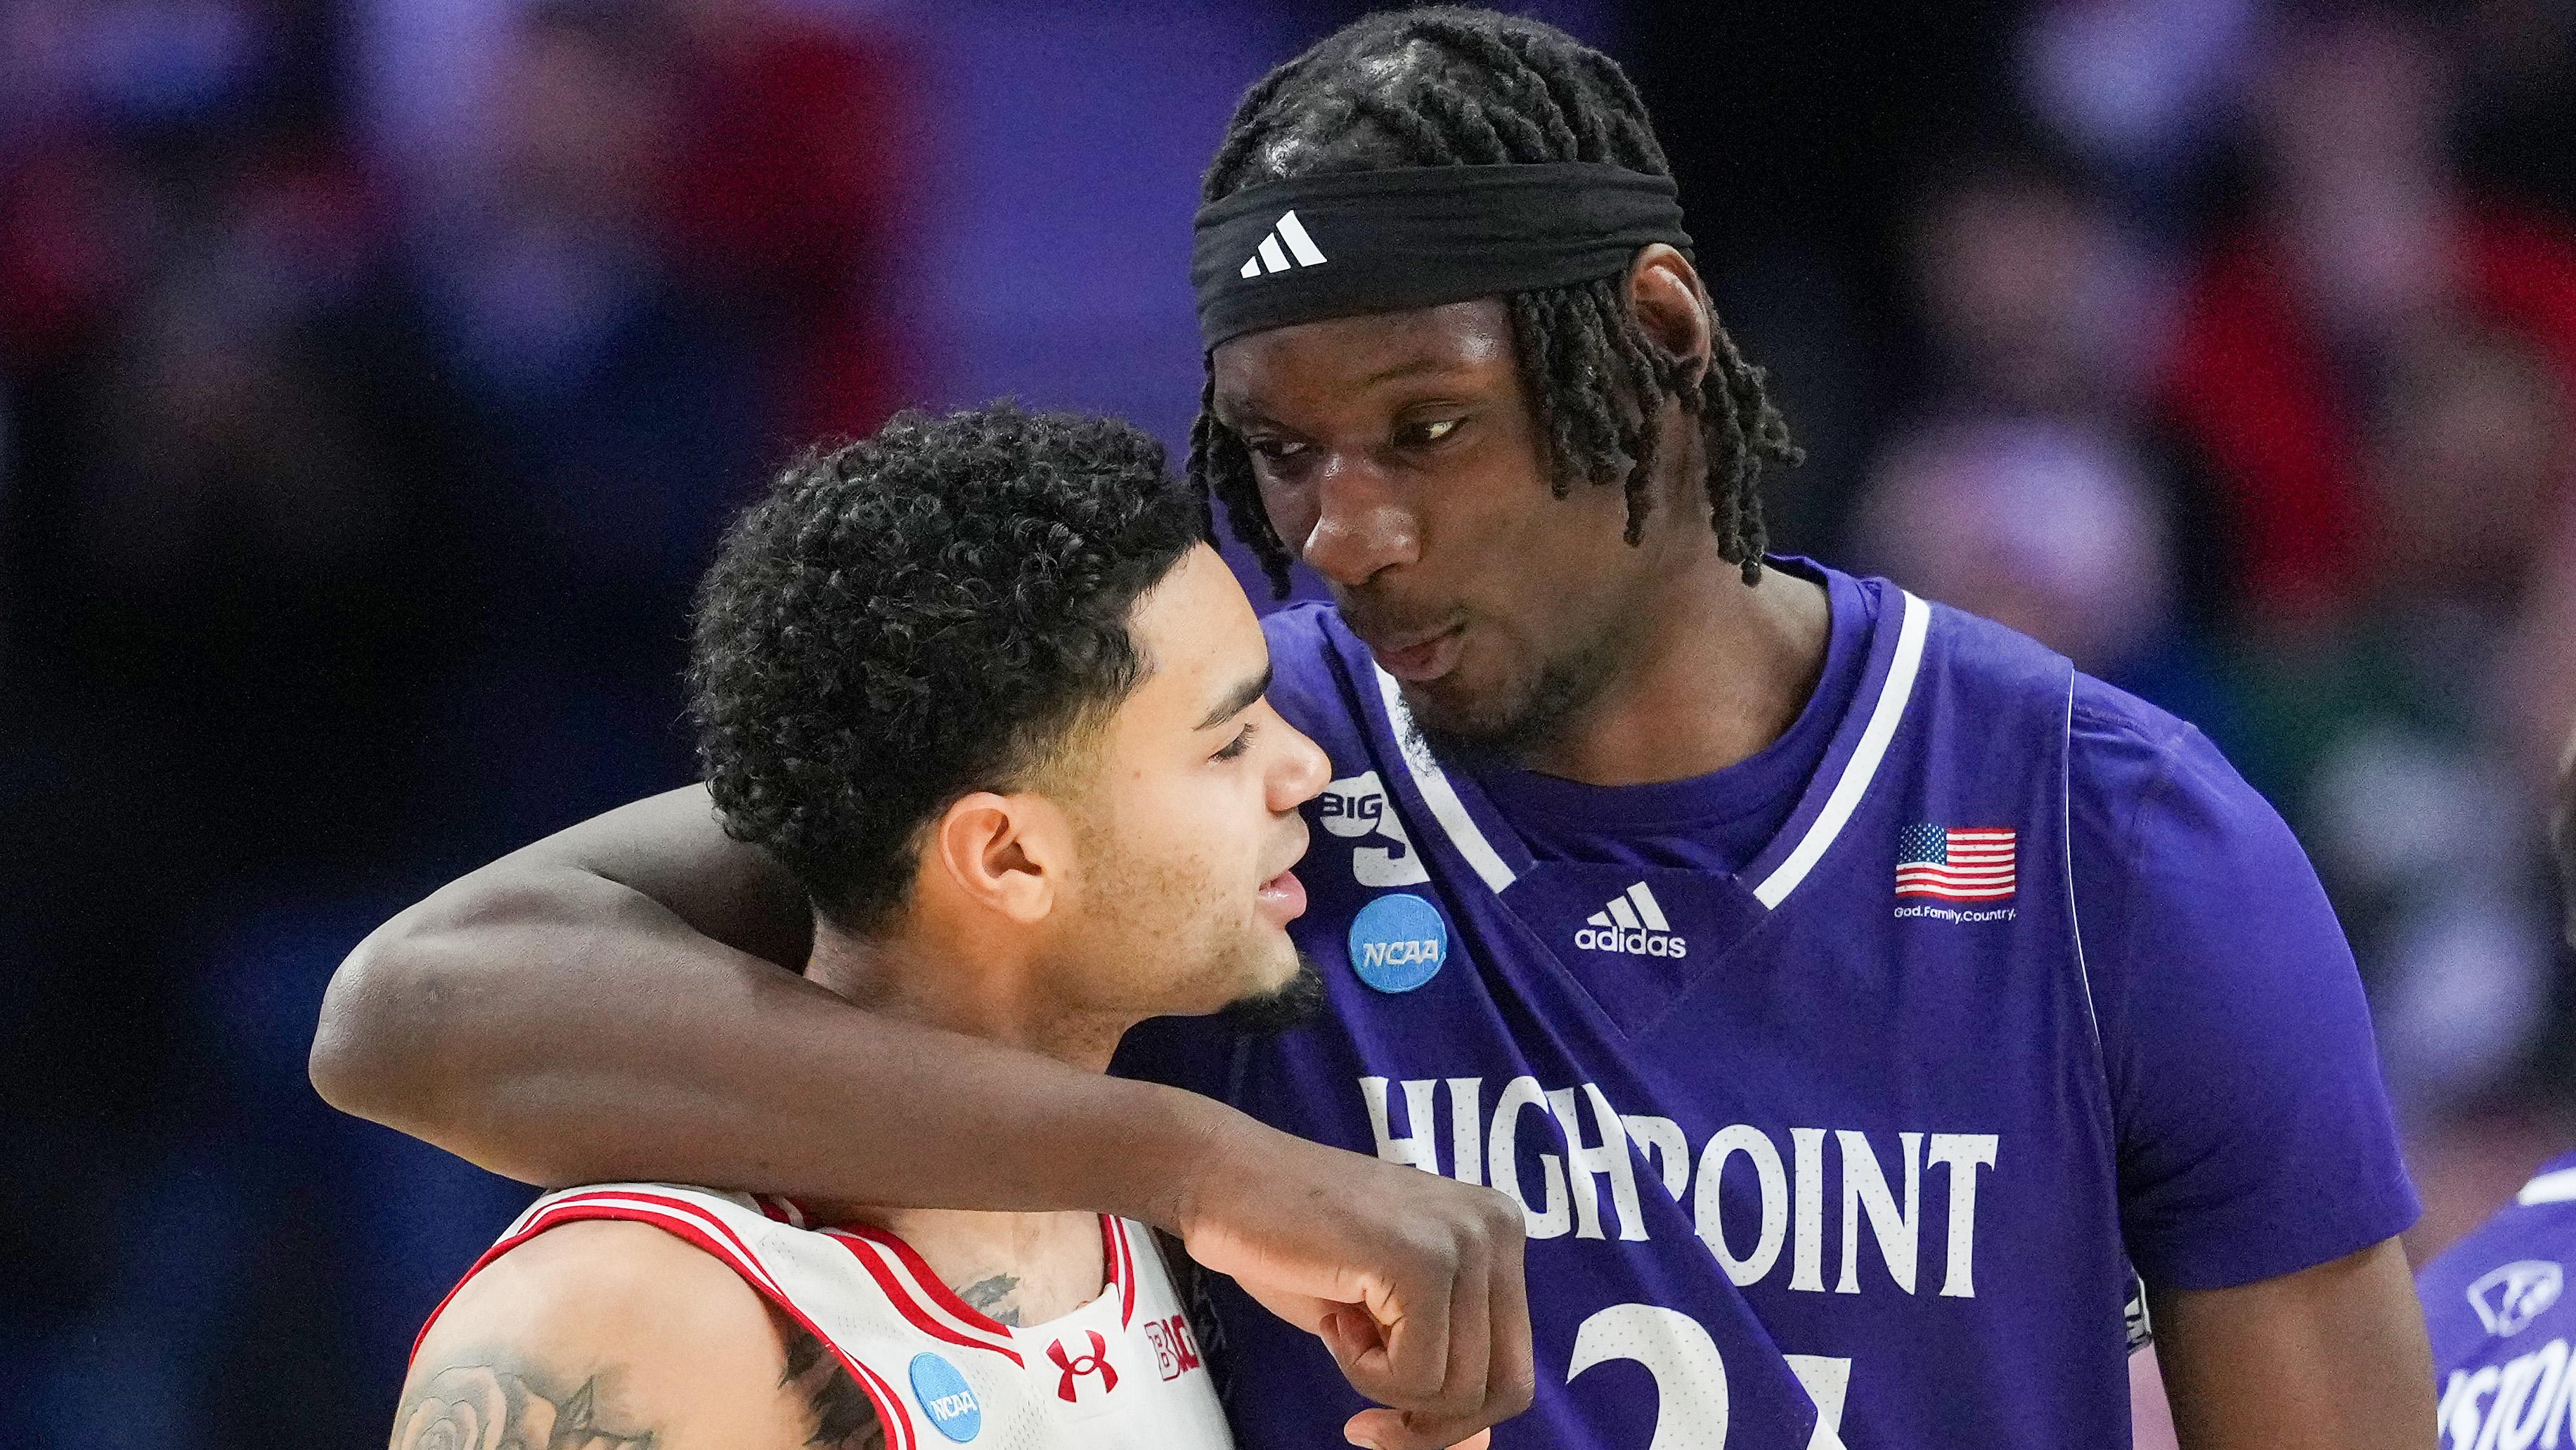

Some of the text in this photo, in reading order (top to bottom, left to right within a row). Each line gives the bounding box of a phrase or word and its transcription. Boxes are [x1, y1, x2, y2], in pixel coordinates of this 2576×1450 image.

[1318, 791, 1383, 820] BIG
[1894, 905, 2017, 925] God.Family.Country.
[1362, 939, 1439, 968] NCAA
[1574, 926, 1687, 959] adidas
[1358, 1075, 2000, 1299] HIGH POINT
[929, 1390, 978, 1422] NCAA
